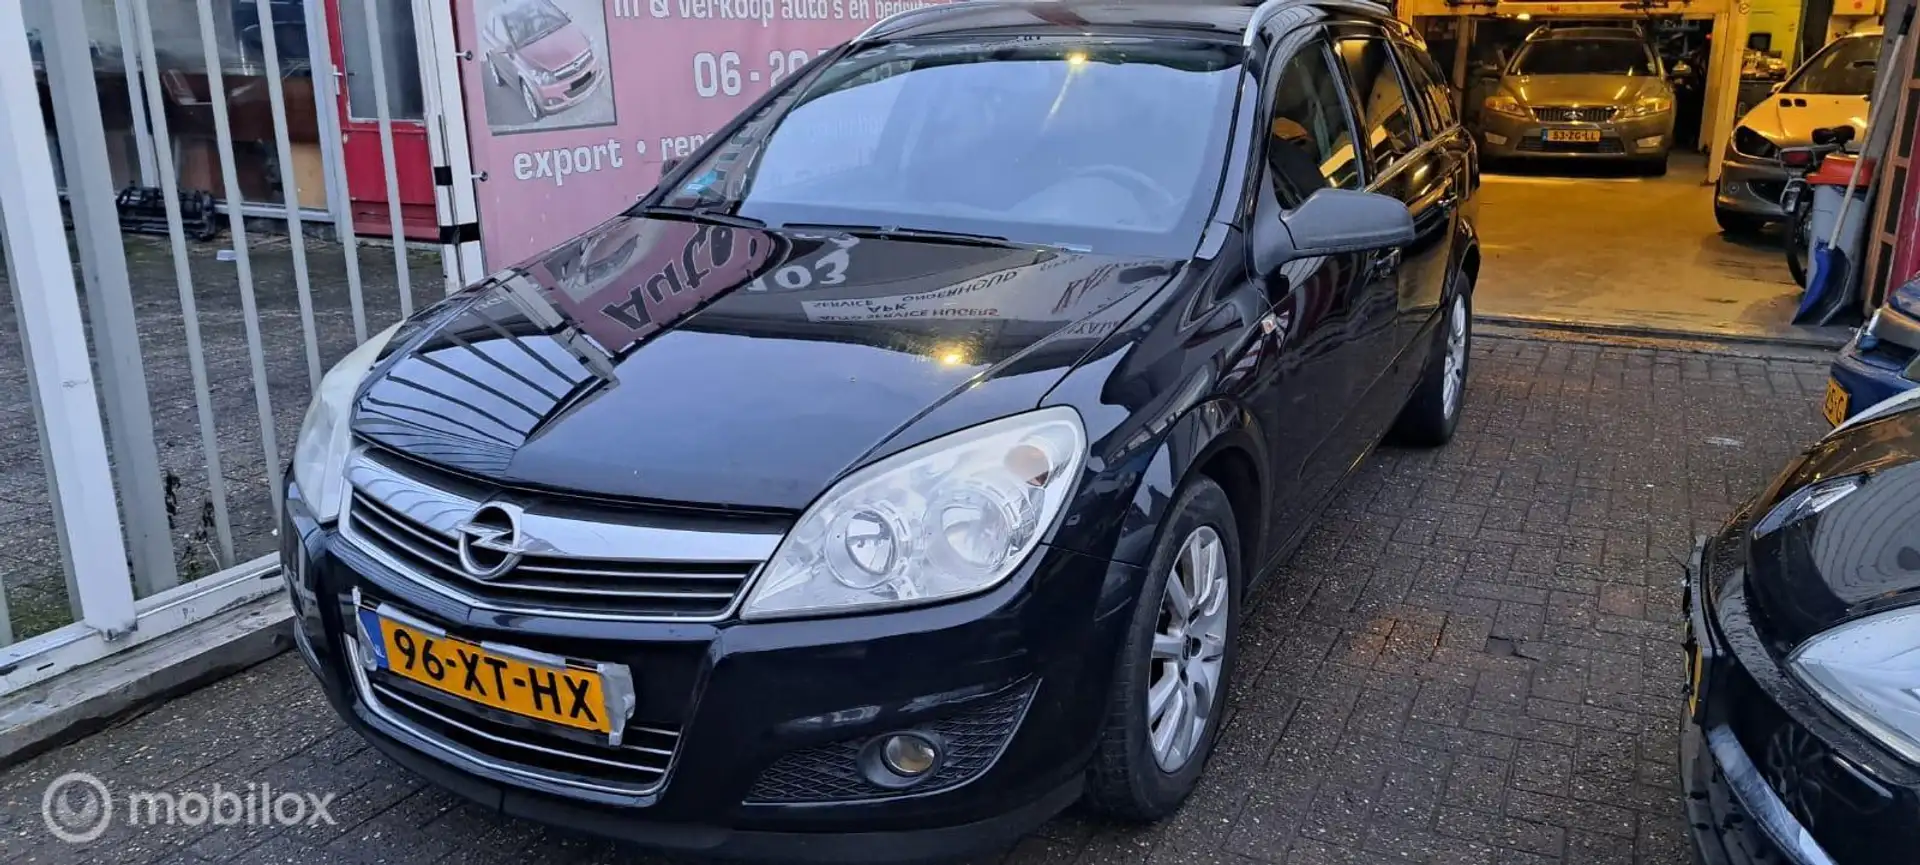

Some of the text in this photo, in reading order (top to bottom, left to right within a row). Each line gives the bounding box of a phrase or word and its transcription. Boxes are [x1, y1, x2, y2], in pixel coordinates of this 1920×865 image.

[649, 0, 670, 18] &
[679, 0, 775, 27] verkoop
[781, 0, 844, 19] auto's
[849, 0, 870, 19] en
[693, 51, 741, 97] 06
[768, 50, 829, 88] 20
[513, 138, 624, 186] export
[394, 628, 597, 722] 96-XT-HX
